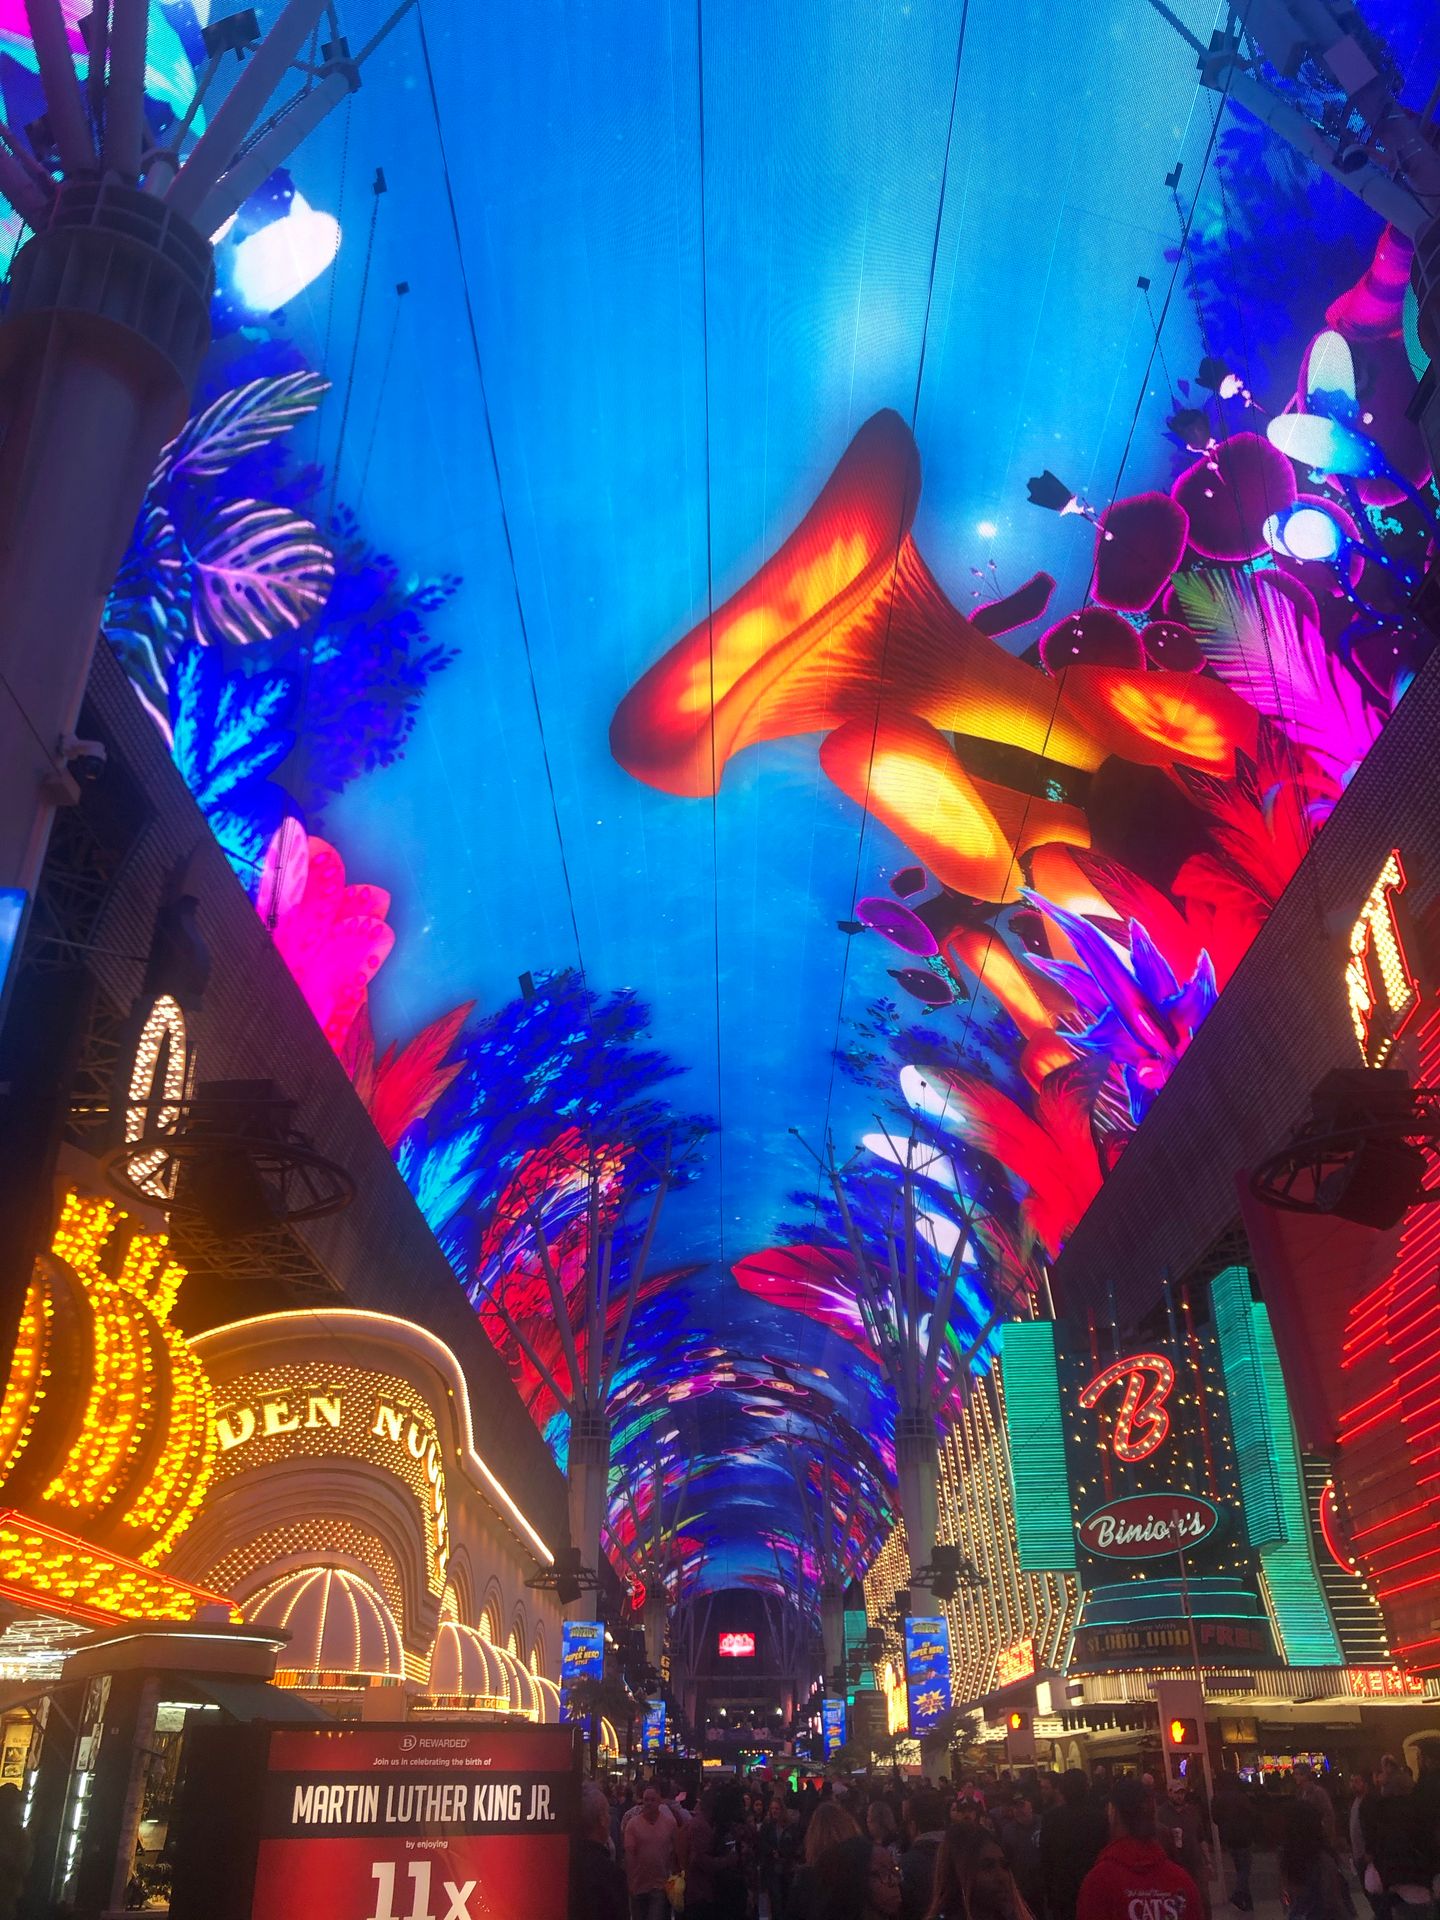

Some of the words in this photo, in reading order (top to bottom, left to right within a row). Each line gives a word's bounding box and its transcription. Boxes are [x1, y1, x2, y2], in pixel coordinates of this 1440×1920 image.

[214, 1392, 343, 1451] DEN
[1078, 1352, 1175, 1462] B
[1088, 1511, 1206, 1548] Binion's
[1201, 1624, 1264, 1649] FREE
[373, 1758, 390, 1766] Join
[401, 1758, 408, 1766] in
[410, 1757, 450, 1767] celebrating
[451, 1758, 464, 1766] the
[465, 1757, 482, 1766] birth
[483, 1757, 492, 1766] of
[291, 1785, 380, 1823] MARTIN
[385, 1784, 468, 1823] LUTHER
[472, 1784, 521, 1821] KING
[526, 1784, 556, 1821] JR.
[405, 1840, 415, 1850] by
[417, 1840, 448, 1849] enjoying
[366, 1861, 477, 1920] 11x
[1128, 1898, 1179, 1920] CATS
